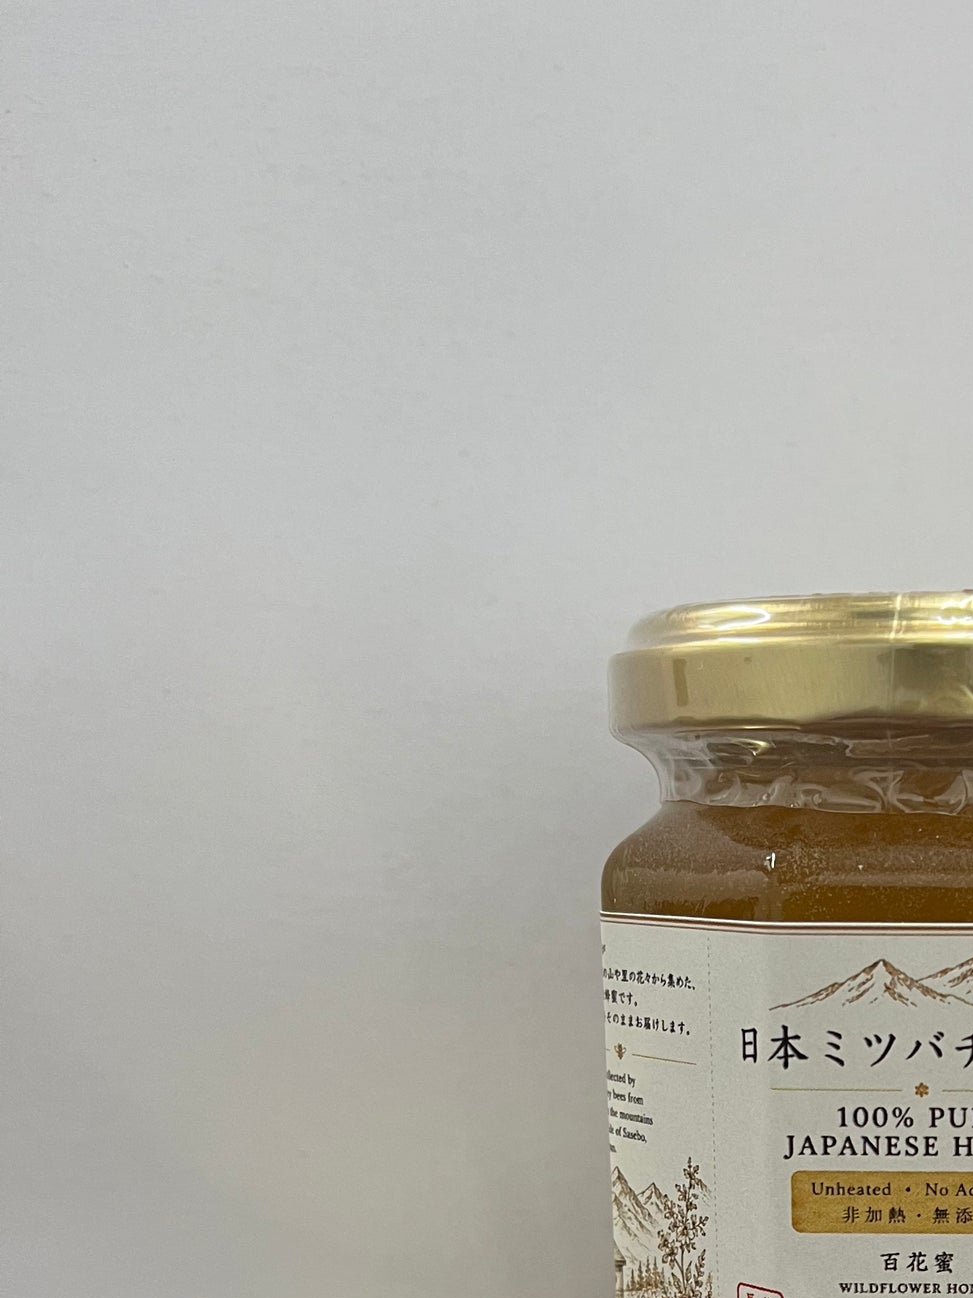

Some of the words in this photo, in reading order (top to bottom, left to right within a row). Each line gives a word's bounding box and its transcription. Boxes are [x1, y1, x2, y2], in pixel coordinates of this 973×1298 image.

[837, 1106, 914, 1129] 100%
[783, 1135, 939, 1160] JAPANESE
[811, 1182, 892, 1197] Unheated
[925, 1183, 948, 1198] No
[880, 1252, 954, 1274] 百花蜜
[839, 1282, 942, 1295] WILDFLOWER
